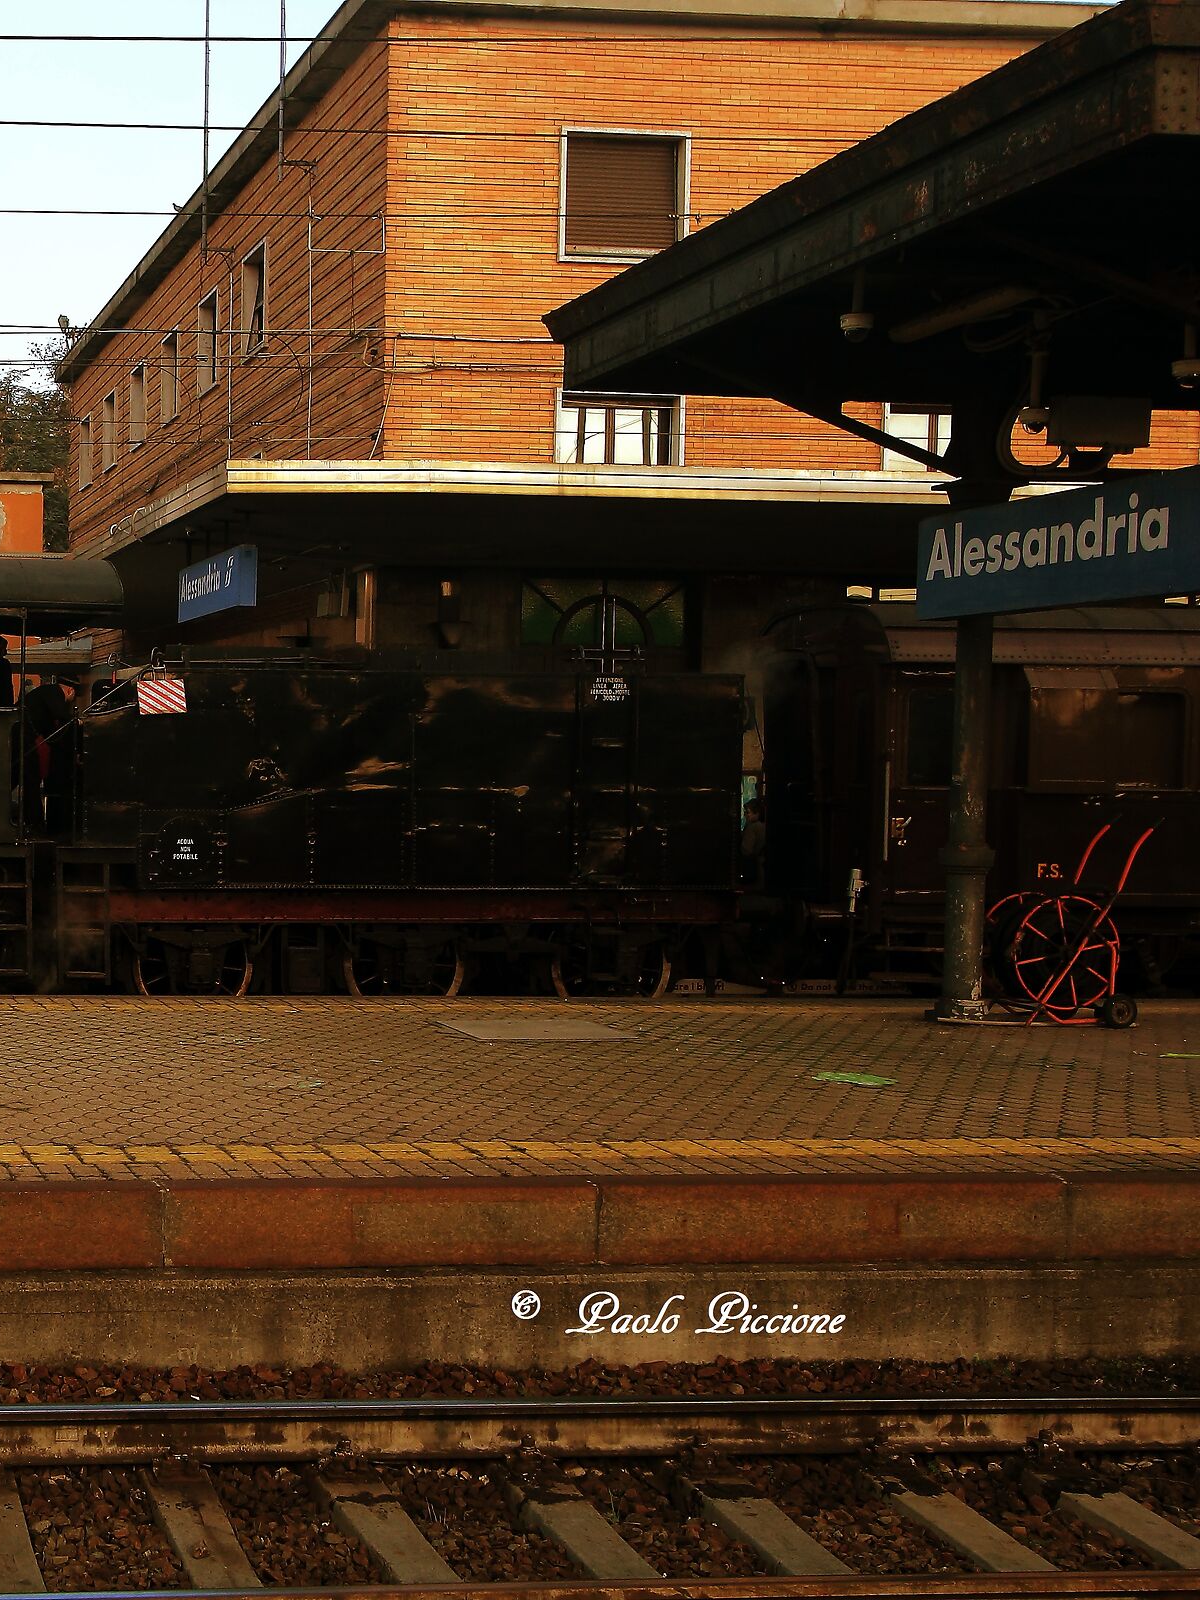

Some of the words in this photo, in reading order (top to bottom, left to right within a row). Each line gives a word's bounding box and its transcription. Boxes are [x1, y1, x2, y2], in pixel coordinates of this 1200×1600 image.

[925, 492, 1170, 581] Alessandria
[180, 562, 221, 603] Alessandria
[1037, 862, 1064, 879] F.S.
